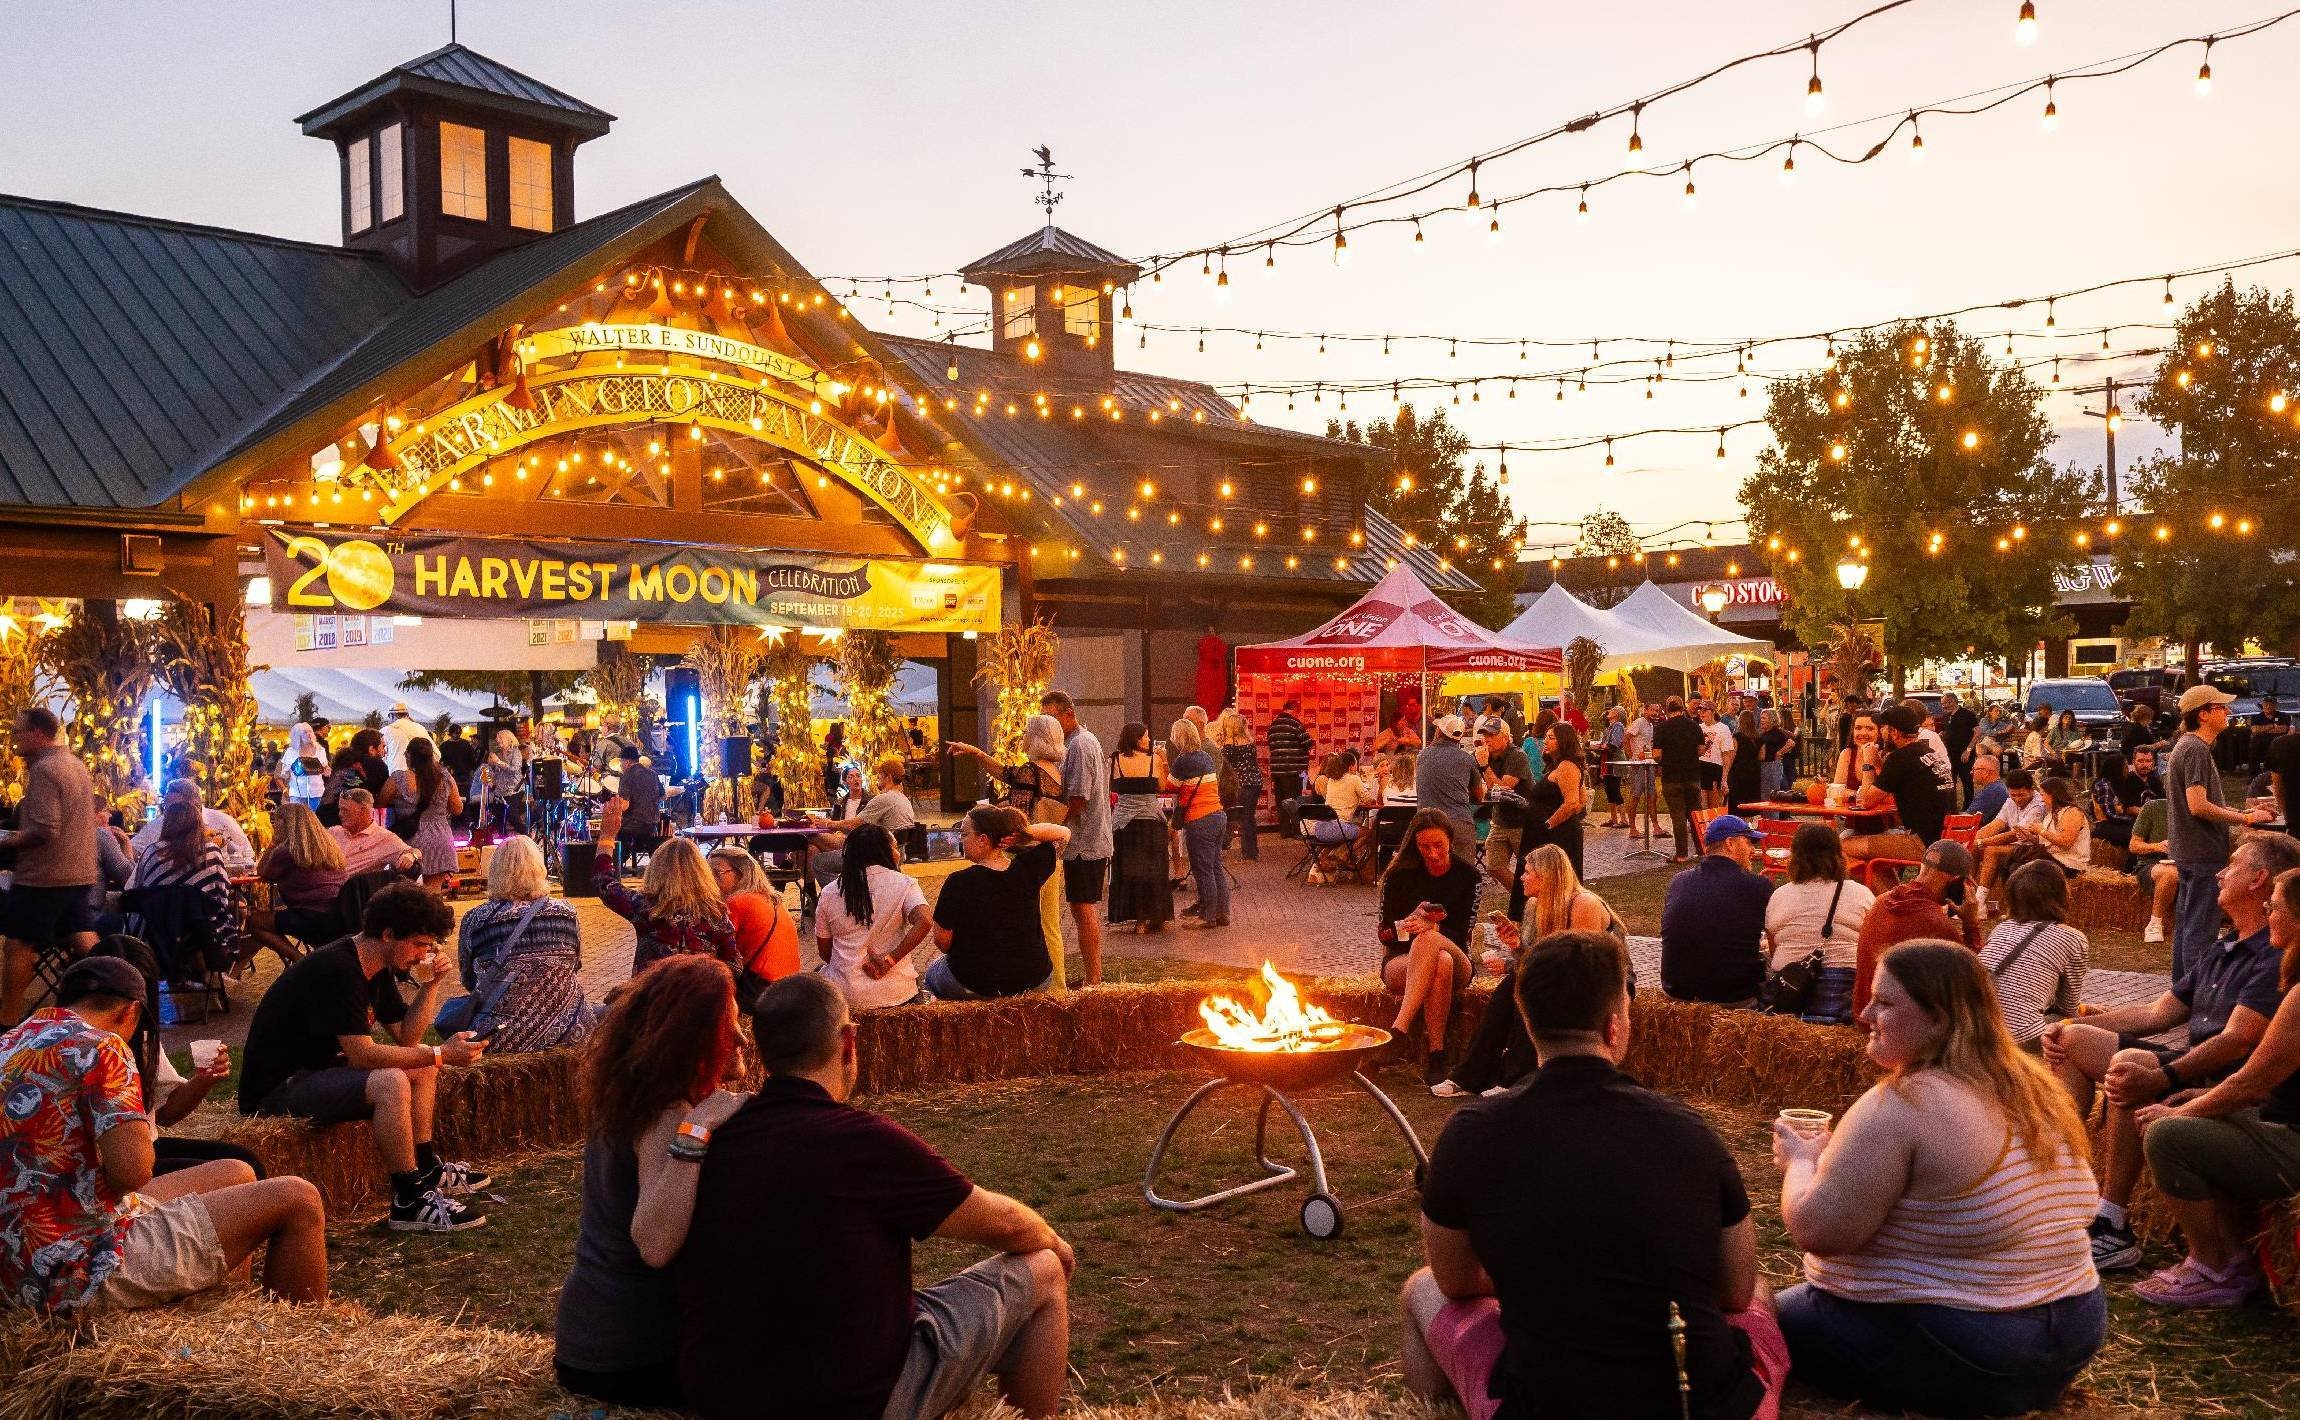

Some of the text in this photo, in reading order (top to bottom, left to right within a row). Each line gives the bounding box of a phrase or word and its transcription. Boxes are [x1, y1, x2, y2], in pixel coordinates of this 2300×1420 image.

[570, 328, 652, 347] WALTER
[662, 331, 678, 347] E.
[398, 376, 933, 524] FARMINGTON PAVILION
[414, 554, 618, 601] HARVEST
[628, 563, 758, 607] MOON
[768, 566, 861, 597] CELEBRATION
[1691, 583, 1735, 606] CD
[770, 602, 840, 617] SEPTEMBER
[878, 606, 905, 618] 2025
[345, 629, 363, 643] 2019
[1320, 620, 1384, 638] ONE
[318, 632, 336, 646] 2018
[532, 632, 547, 644] 2021
[1287, 655, 1365, 671] cuone.org
[1468, 655, 1527, 671] cuone.org
